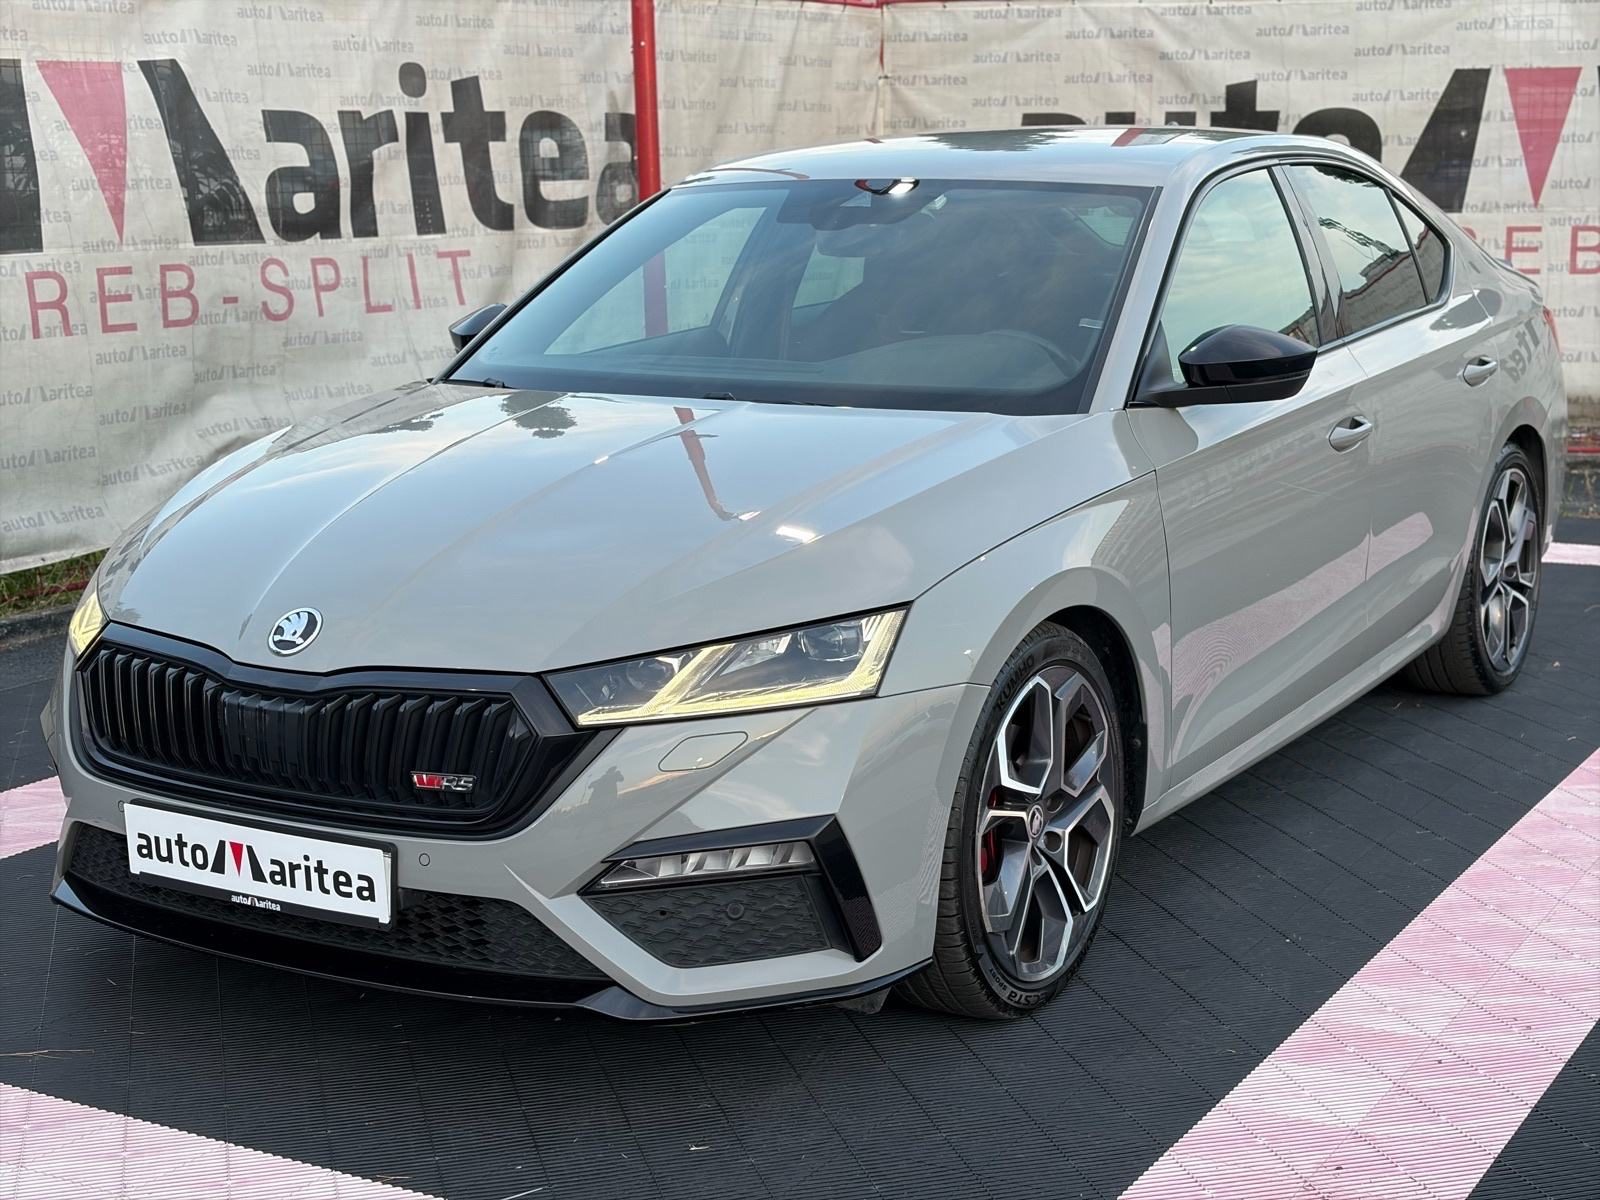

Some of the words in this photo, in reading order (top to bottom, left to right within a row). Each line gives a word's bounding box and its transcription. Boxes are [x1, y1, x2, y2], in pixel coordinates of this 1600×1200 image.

[237, 5, 323, 22] autoMaritea
[973, 8, 1062, 20] autoMaritea
[1160, 4, 1252, 17] autoMaritea
[416, 14, 494, 29] autoMaritea
[1455, 17, 1554, 31] autoMaritea
[144, 28, 238, 47] autoMaritea
[1065, 27, 1154, 41] autoMaritea
[1255, 23, 1350, 38] autoMaritea
[332, 37, 414, 53] autoMaritea
[1354, 43, 1451, 57] autoMaritea
[973, 51, 1061, 64] autoMaritea
[1158, 48, 1251, 62] autoMaritea
[247, 62, 331, 79] autoMaritea
[1064, 71, 1153, 84] autoMaritea
[1254, 69, 1348, 82] autoMaritea
[972, 95, 1059, 108] autoMaritea
[1352, 88, 1440, 102] autoMarite
[1461, 226, 1600, 274] EB
[25, 250, 471, 339] REB-SPLIT
[282, 329, 363, 347] autoMaritea
[96, 343, 187, 366] autoMaritea
[0, 383, 93, 406] utoMaritea
[284, 382, 373, 401] autoMaritea
[99, 402, 187, 426] autoMaritea
[0, 445, 96, 470] utoMaritea
[3, 505, 104, 533] autoMaritea
[993, 653, 1035, 712] KUMHO
[136, 832, 376, 903] autoMaritea
[231, 894, 281, 912] autoMaritea
